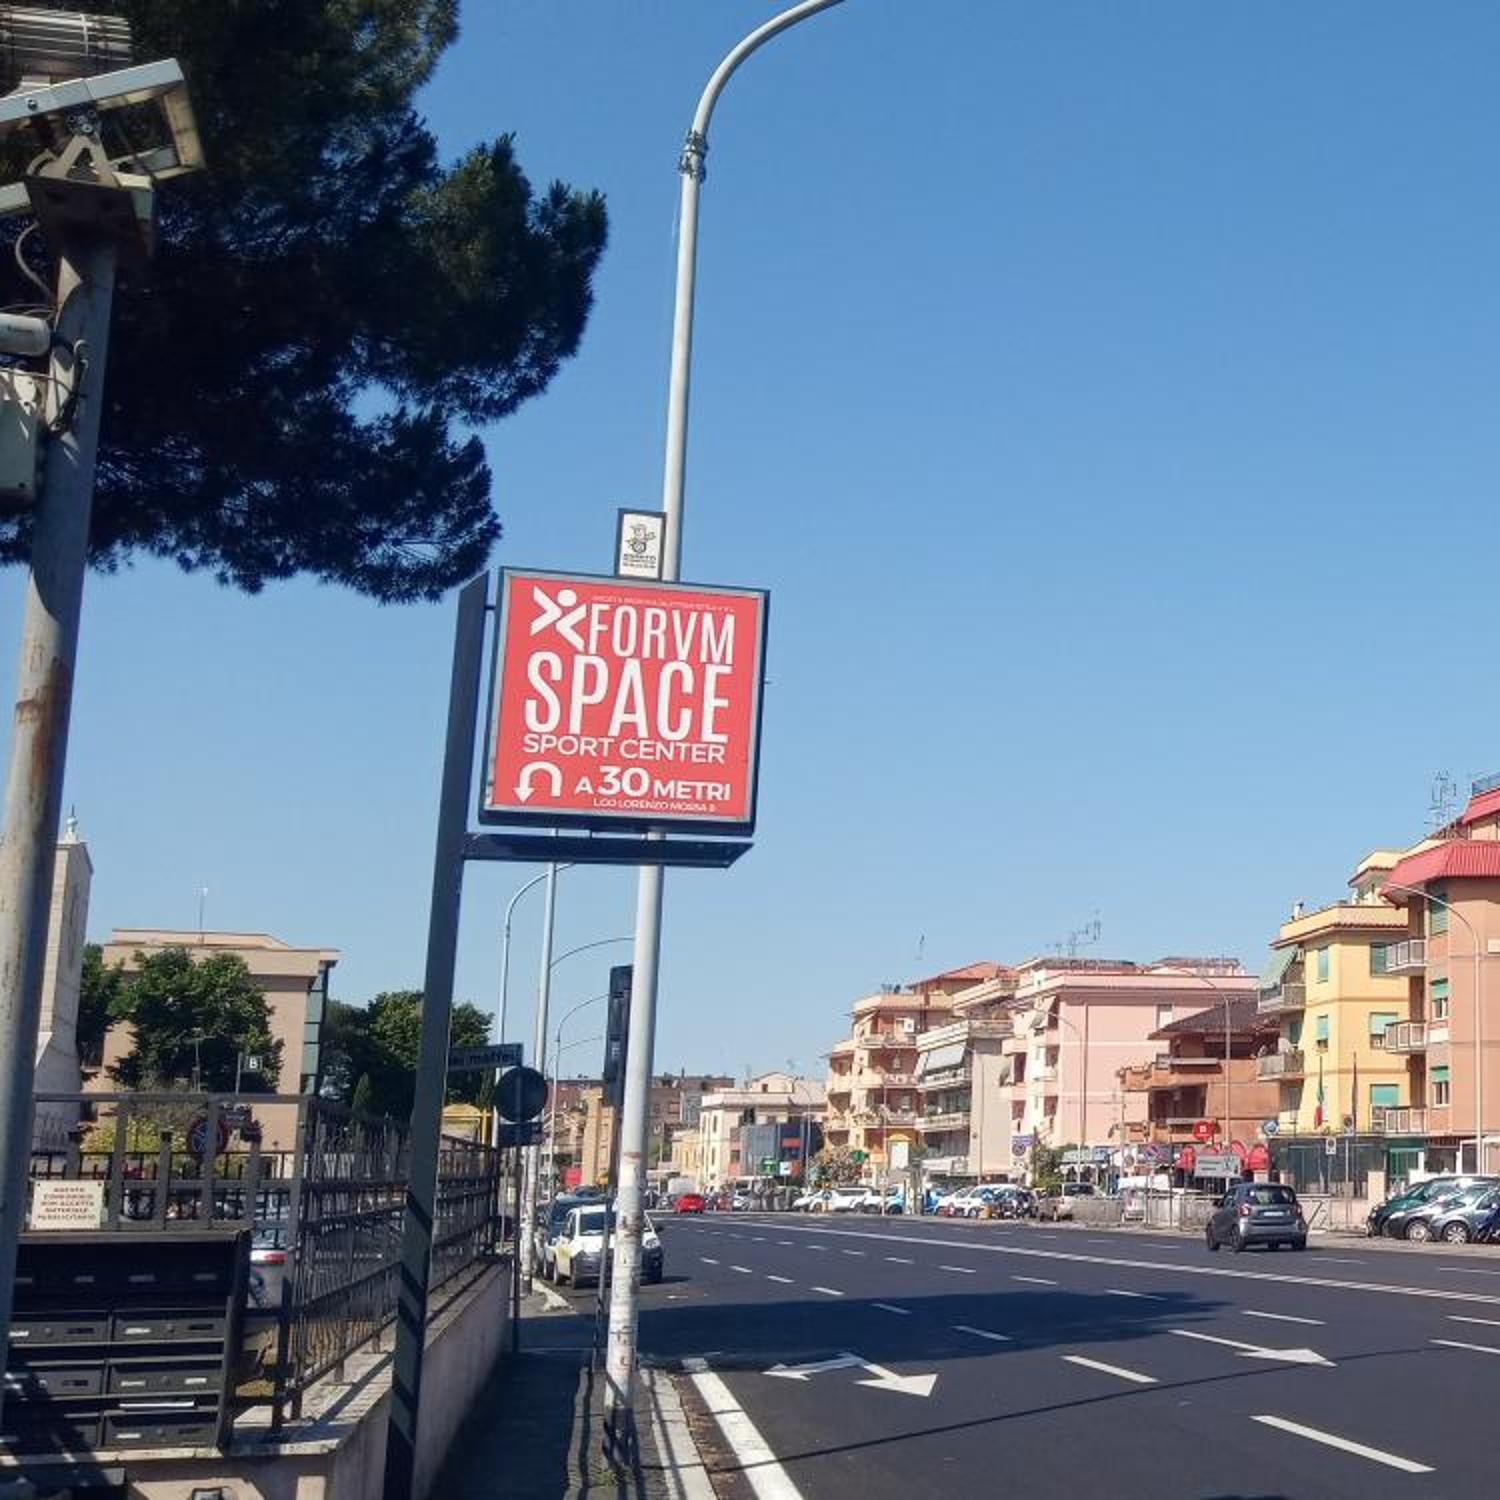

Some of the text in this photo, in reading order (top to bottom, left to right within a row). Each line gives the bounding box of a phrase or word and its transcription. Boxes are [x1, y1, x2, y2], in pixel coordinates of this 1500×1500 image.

[588, 603, 736, 665] FORVM
[524, 650, 733, 743] SPACE
[523, 733, 726, 765] SPORT CENTER
[574, 765, 731, 801] A 30 METRI
[618, 799, 670, 810] LORENZO
